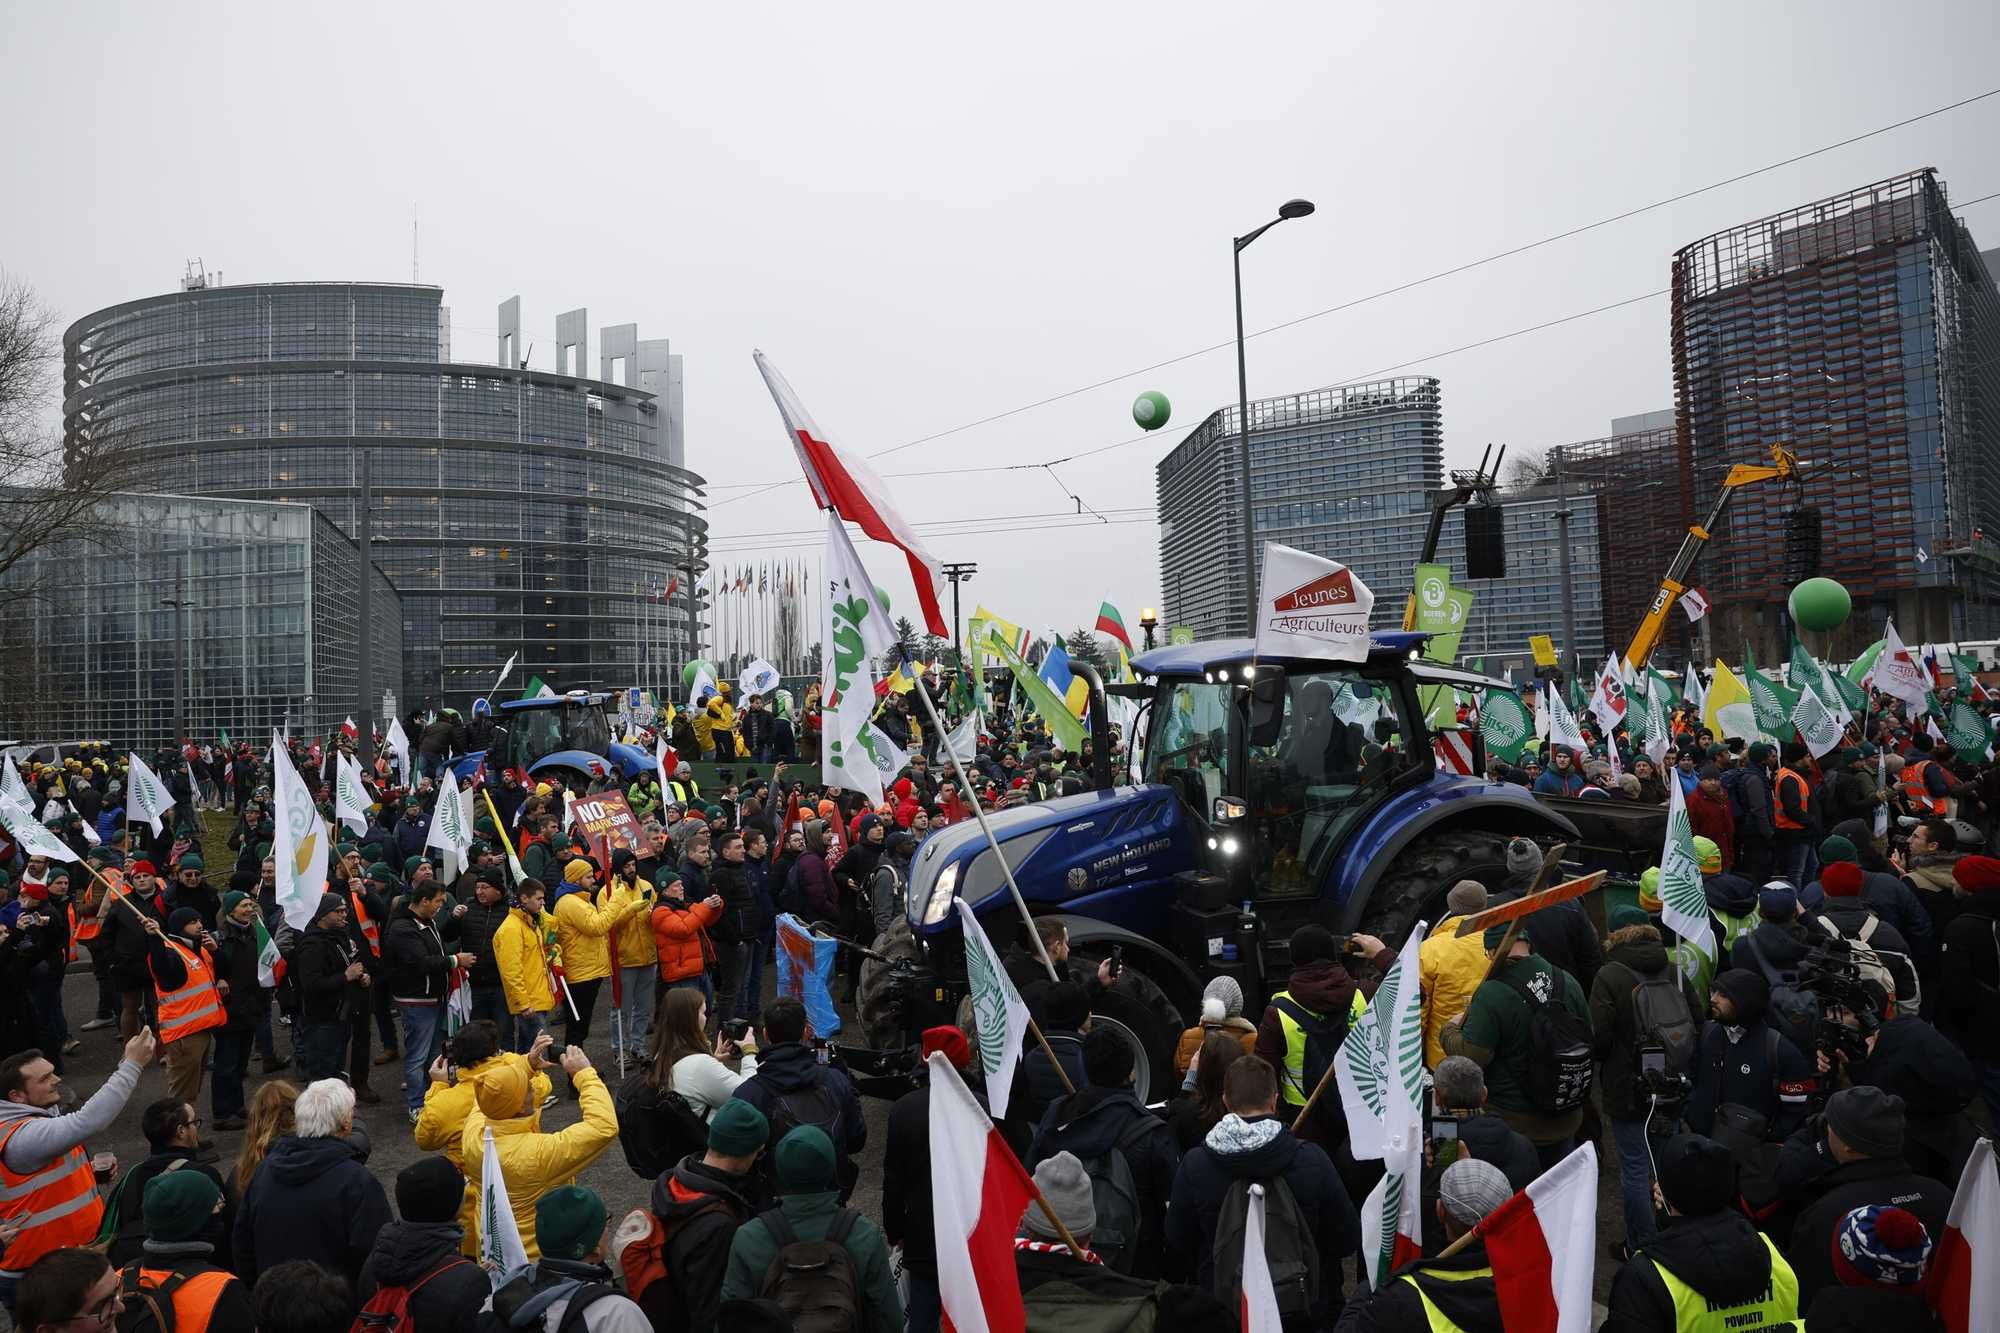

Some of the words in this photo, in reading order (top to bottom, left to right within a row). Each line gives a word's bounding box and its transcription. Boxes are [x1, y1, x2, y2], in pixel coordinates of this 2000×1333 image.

[1291, 584, 1348, 608] Jeunes
[1279, 615, 1366, 636] Agriculteurs
[576, 801, 606, 823] NO
[585, 812, 632, 834] MARKSUR
[1093, 854, 1121, 873] NEW
[1121, 837, 1172, 862] HOLLAND
[1724, 1311, 1764, 1329] POWIATU
